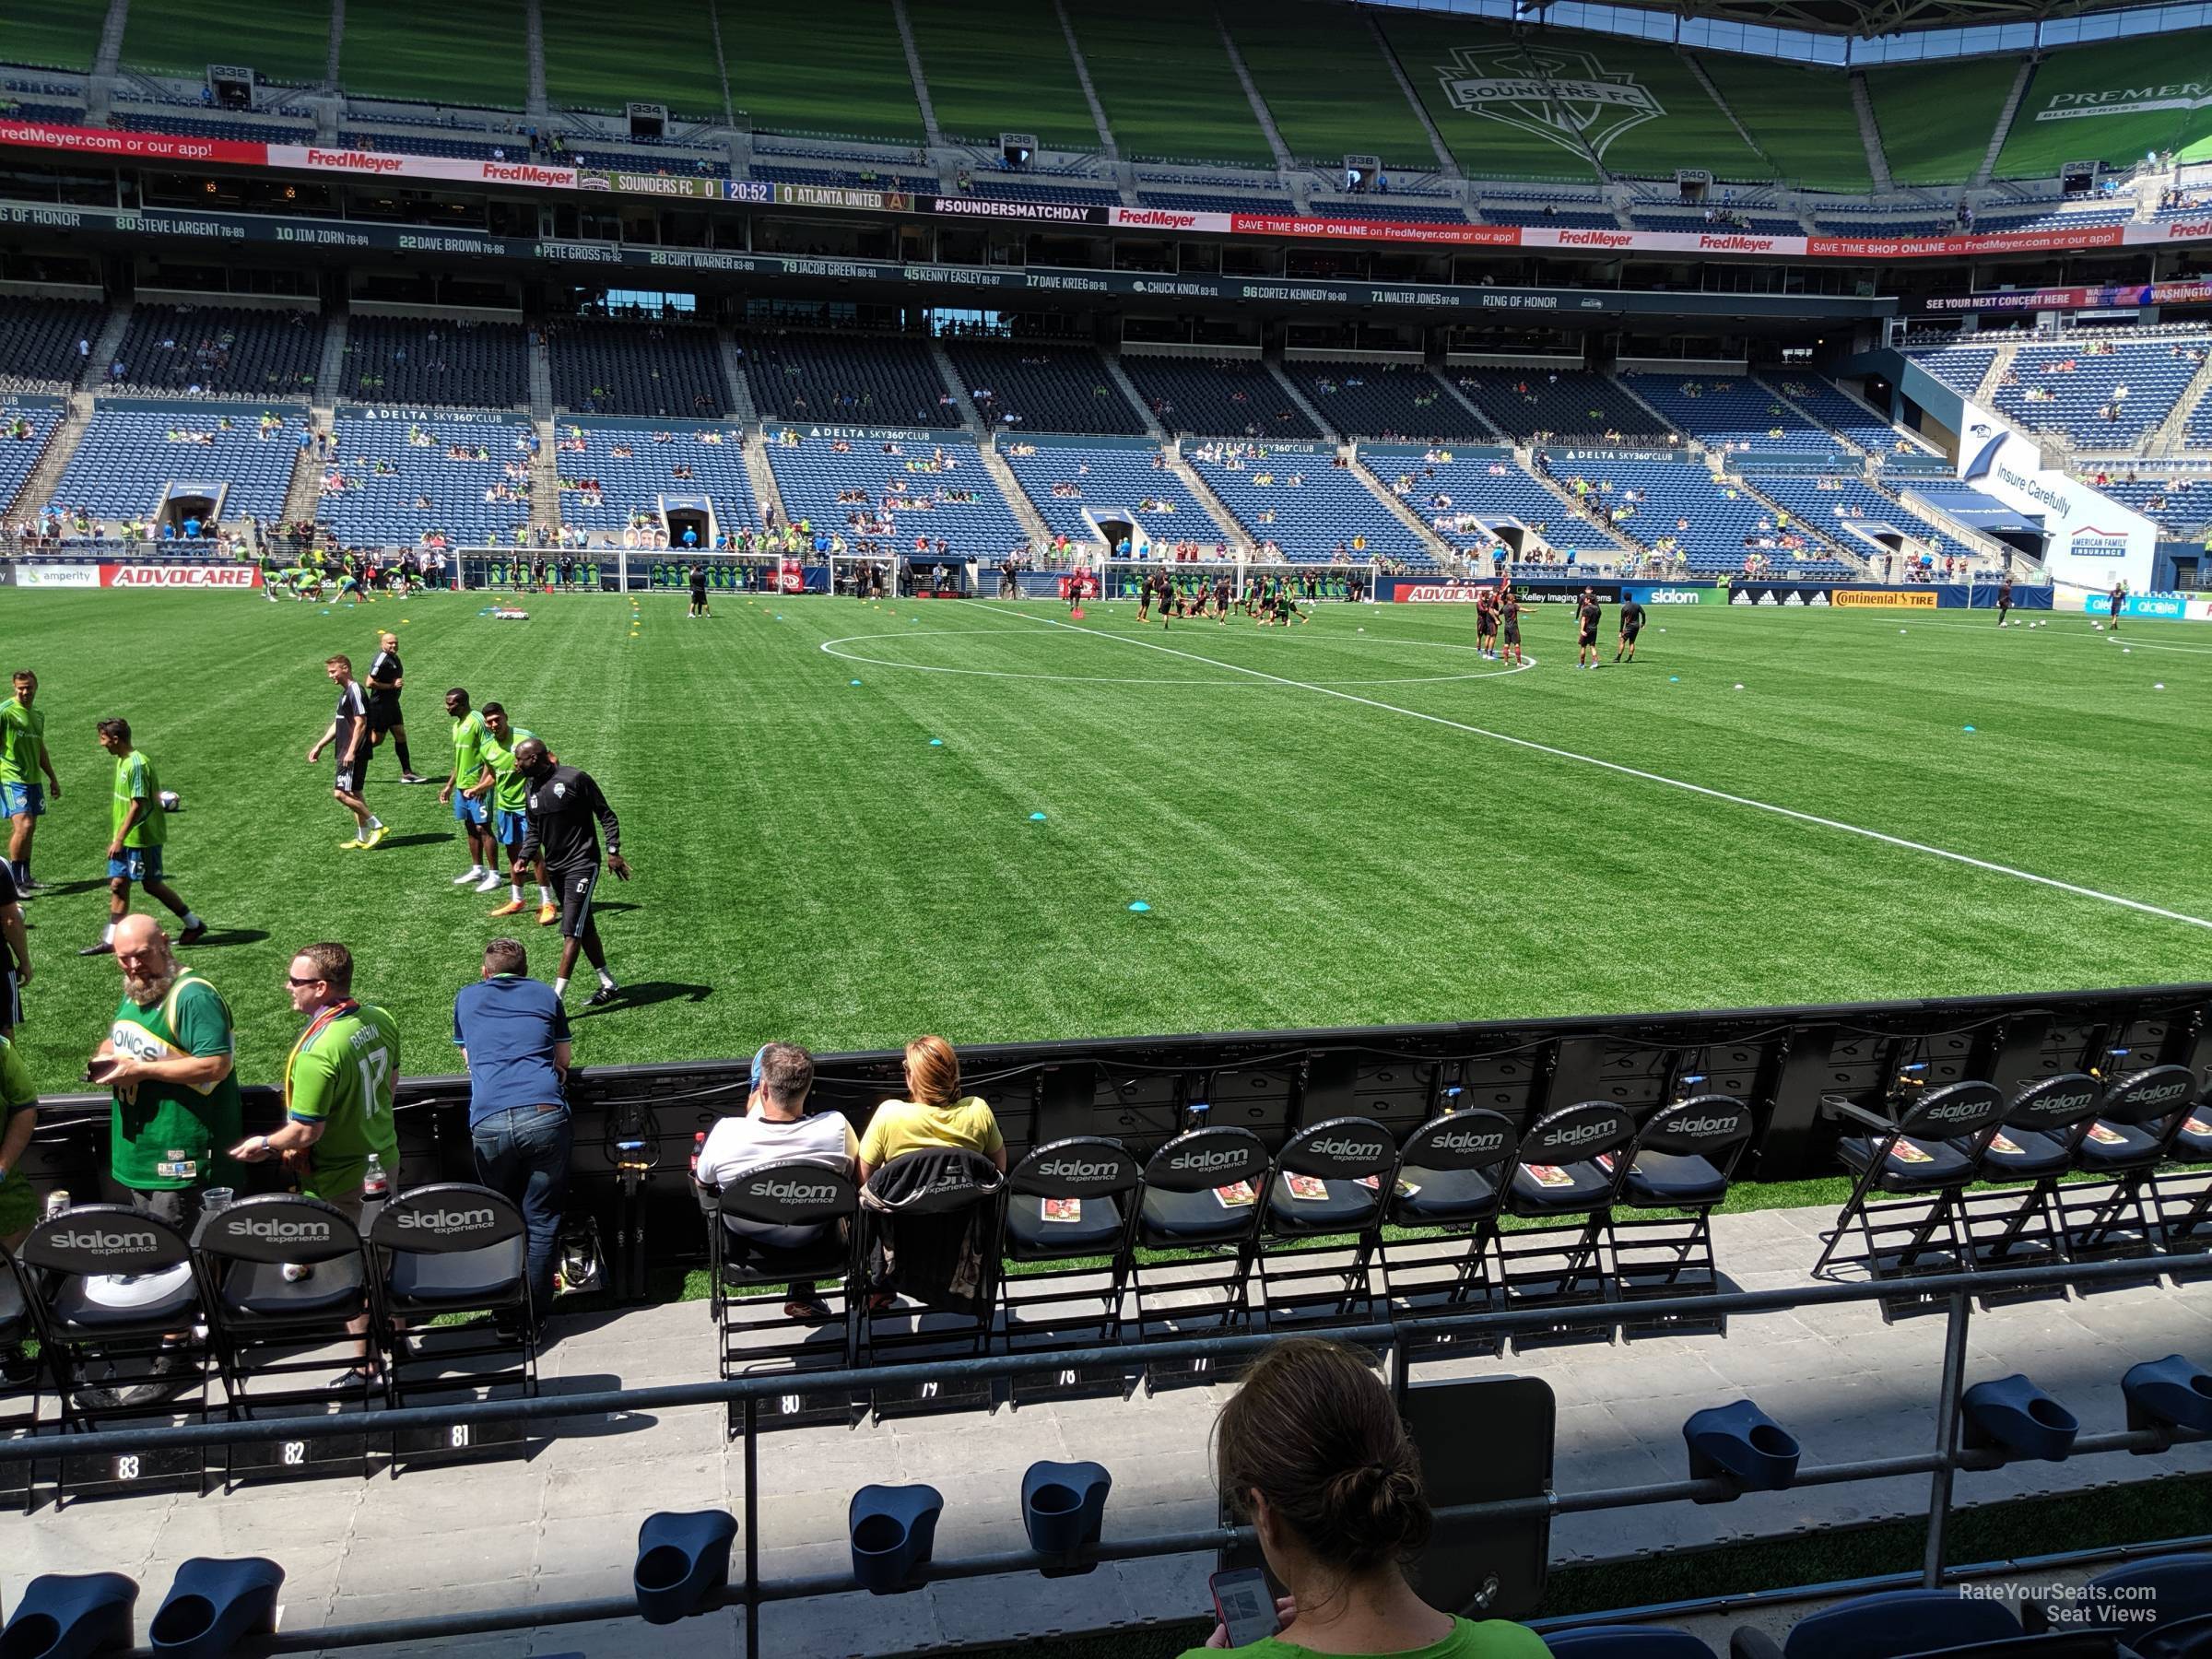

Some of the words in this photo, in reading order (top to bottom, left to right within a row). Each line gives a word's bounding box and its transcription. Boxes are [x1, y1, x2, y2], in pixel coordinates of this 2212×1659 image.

[215, 66, 250, 77] 332
[1606, 91, 1645, 105] FC
[2048, 83, 2212, 108] PREMER
[632, 104, 661, 114] 334
[2043, 109, 2081, 118] BLUE
[0, 125, 122, 150] redMeyer.com
[127, 140, 141, 151] or
[147, 142, 173, 154] our
[179, 143, 213, 158] app!
[1349, 156, 1373, 165] 338
[1681, 170, 1706, 180] 340
[618, 175, 677, 194] SOUNDERS
[680, 180, 693, 194] FC
[705, 181, 713, 196] 0
[731, 182, 767, 201] 20:52
[784, 187, 792, 202] 0
[797, 188, 843, 206] ATLANTA
[845, 191, 882, 207] UNITED
[12, 208, 29, 223] OF
[34, 210, 80, 227] HONOR
[935, 198, 1089, 221] #SOUNDERSMATCHDAY
[116, 218, 135, 230] 80
[137, 219, 170, 233] STEVE
[172, 220, 219, 237] LARGENT
[220, 226, 244, 238] 76-89
[1238, 219, 1263, 230] SAVE
[1266, 221, 1290, 231] TIME
[1293, 223, 1324, 233] SHOP
[1327, 224, 1368, 235] ONLINE
[1371, 228, 1382, 236] on
[1385, 227, 1460, 241] FredMeyer.com
[1475, 232, 1491, 241] our
[1493, 232, 1514, 243] app!
[276, 228, 293, 241] 10
[295, 229, 315, 242] JIM
[317, 229, 345, 244] ZORN
[346, 234, 369, 246] 76-84
[399, 235, 417, 248] 22
[418, 236, 442, 251] DAVE
[445, 238, 481, 253] BROWN
[482, 243, 505, 254] 76-86
[1813, 242, 1838, 253] SAVE
[1841, 243, 1865, 253] TIME
[1866, 243, 1899, 253] SHOP
[1901, 242, 1946, 253] ONLINE
[1965, 237, 2051, 252] FredMeyer.com
[2053, 237, 2065, 245] or
[2067, 236, 2087, 244] our
[2089, 232, 2115, 244] app!
[543, 245, 566, 259] PETE
[569, 246, 600, 261] GROSS
[602, 252, 622, 263] 76-92
[651, 253, 667, 265] 28
[668, 253, 692, 266] CURT
[694, 254, 733, 269] WARNER
[734, 260, 754, 271] 83-89
[782, 261, 797, 273] 79
[798, 262, 826, 275] JACOB
[828, 264, 856, 277] GREEN
[857, 268, 877, 278] 80-91
[904, 268, 919, 280] 45
[920, 269, 948, 283] KENNY
[951, 270, 982, 284] EASLEY
[982, 276, 1000, 286] 81-87
[1026, 276, 1039, 287] 17
[1040, 276, 1060, 288] DAVE
[1062, 277, 1088, 289] KRIEG
[1088, 281, 1107, 290] 80-91
[1147, 282, 1175, 294] CHUCK
[1177, 283, 1199, 295] KNOX
[1200, 287, 1218, 296] 83-91
[1243, 287, 1258, 297] 96
[1258, 288, 1288, 300] CORTEZ
[1290, 288, 1328, 301] KENNEDY
[1371, 291, 1383, 302] 71
[1383, 291, 1415, 303] WALTER
[1417, 292, 1441, 304] JONES
[1483, 295, 1508, 307] RING
[1510, 296, 1523, 307] OF
[1525, 296, 1557, 308] HONOR
[1926, 300, 1943, 309] SEE
[1945, 298, 1971, 309] YOUR
[1972, 296, 1996, 308] NEXT
[1998, 295, 2042, 307] CONCERT
[2044, 293, 2070, 305] HERE
[382, 410, 427, 420] DELTA
[824, 428, 865, 438] DELTA
[1578, 451, 1614, 459] DELTA
[1997, 463, 2026, 490] Insure
[2028, 479, 2071, 519] Carefully
[2072, 538, 2103, 547] AMERICAN
[2104, 538, 2127, 547] FAMILY
[2074, 547, 2122, 556] INSURANCE
[43, 571, 90, 582] amperity
[113, 568, 253, 587] ADVOCARE
[1522, 593, 1546, 603] Kelley
[1548, 593, 1578, 603] Imaging
[1651, 588, 1699, 605] slalom
[1836, 592, 1898, 606] Continental
[1910, 596, 1934, 606] TIRE
[479, 806, 488, 818] 5
[111, 1030, 159, 1062] ONICS
[359, 1046, 388, 1121] 17
[2125, 1083, 2186, 1102] slalom
[1927, 1100, 1992, 1120] slalom
[2030, 1092, 2092, 1112] slalom
[1544, 1119, 1617, 1147] slalom
[1666, 1116, 1739, 1133] slalom
[1690, 1127, 1735, 1137] experience
[1431, 1132, 1503, 1149] slalom
[1571, 1130, 1618, 1147] experience
[1309, 1138, 1382, 1157] slalom
[1455, 1144, 1500, 1154] experience
[1171, 1148, 1249, 1170] slalom
[1333, 1152, 1379, 1162] experience
[1039, 1159, 1119, 1176] slalom
[1198, 1159, 1248, 1173] experience
[1066, 1174, 1116, 1183] experience
[749, 1180, 837, 1197] slalom
[781, 1197, 834, 1206] experience
[229, 1218, 329, 1236] slalom
[397, 1208, 494, 1230] slalom
[433, 1221, 495, 1235] experience
[51, 1230, 157, 1248] slalom
[266, 1232, 330, 1243] experience
[91, 1246, 158, 1255] experience
[453, 1424, 469, 1447] 81
[285, 1441, 305, 1465] 82
[119, 1456, 139, 1480] 83
